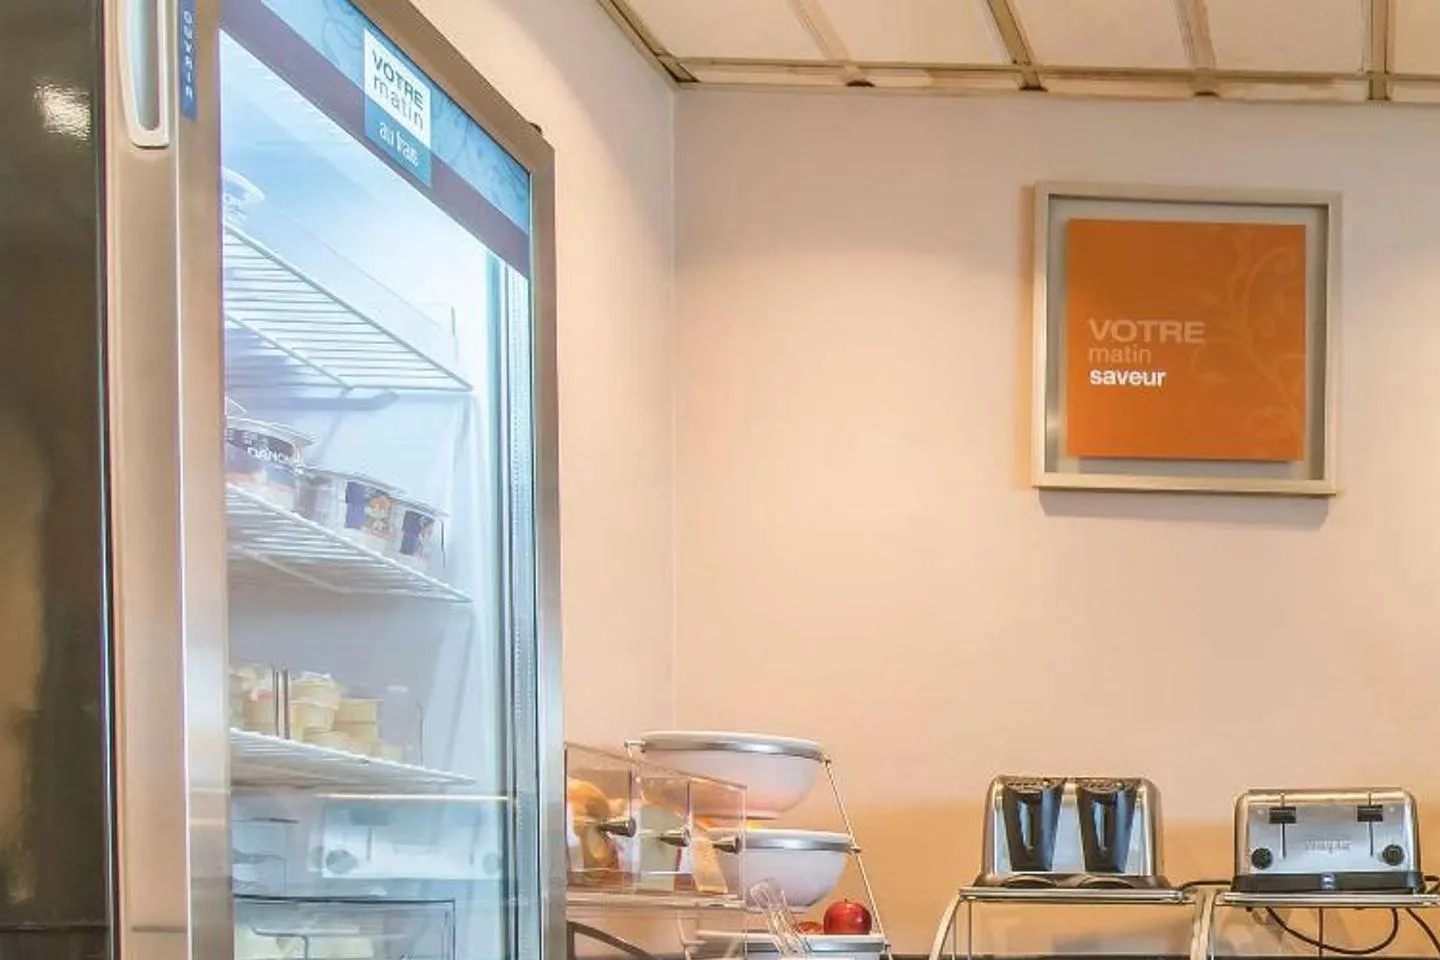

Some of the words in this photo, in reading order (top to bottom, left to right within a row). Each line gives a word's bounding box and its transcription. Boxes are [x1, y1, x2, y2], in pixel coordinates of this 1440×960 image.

[372, 49, 424, 111] VOTRE
[373, 76, 424, 131] matin
[1088, 319, 1206, 344] VOTRE
[1088, 345, 1152, 365] matin
[1090, 369, 1166, 387] saveur
